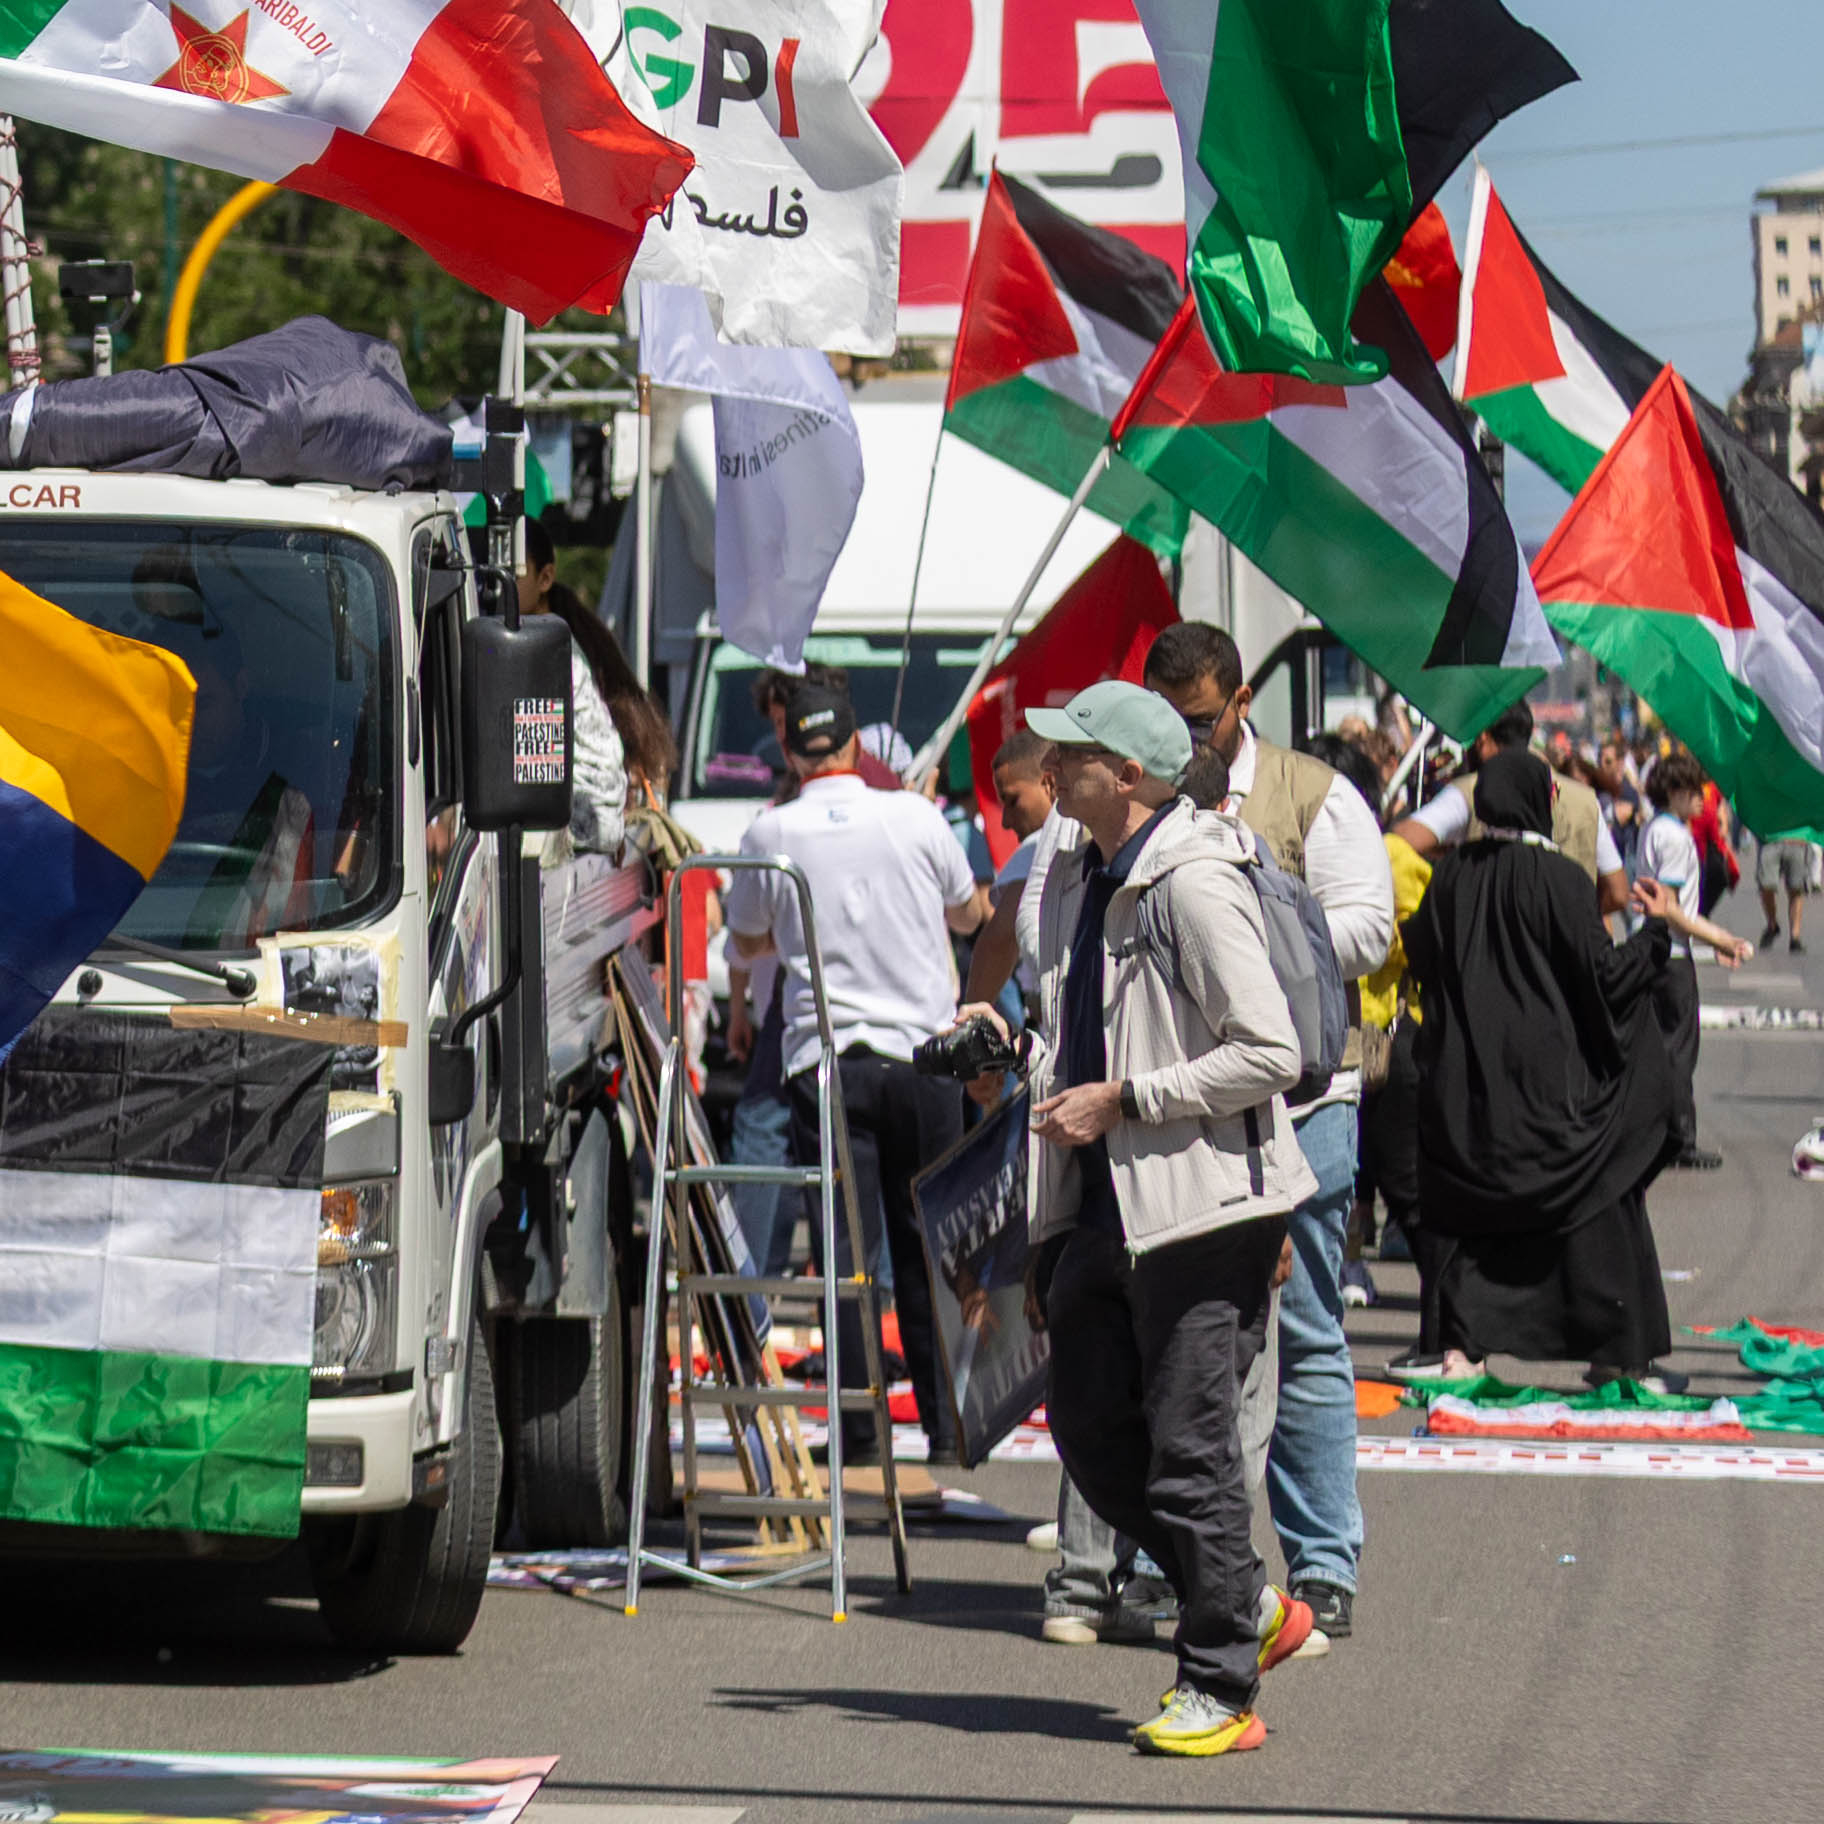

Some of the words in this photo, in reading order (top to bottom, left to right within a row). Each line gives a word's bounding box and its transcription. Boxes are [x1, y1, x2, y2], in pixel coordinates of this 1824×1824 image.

[623, 5, 801, 140] GPI
[515, 699, 552, 714] FREE
[515, 722, 564, 742] PALESTINE
[515, 742, 552, 755] FREE
[515, 763, 564, 782] PALESTINE
